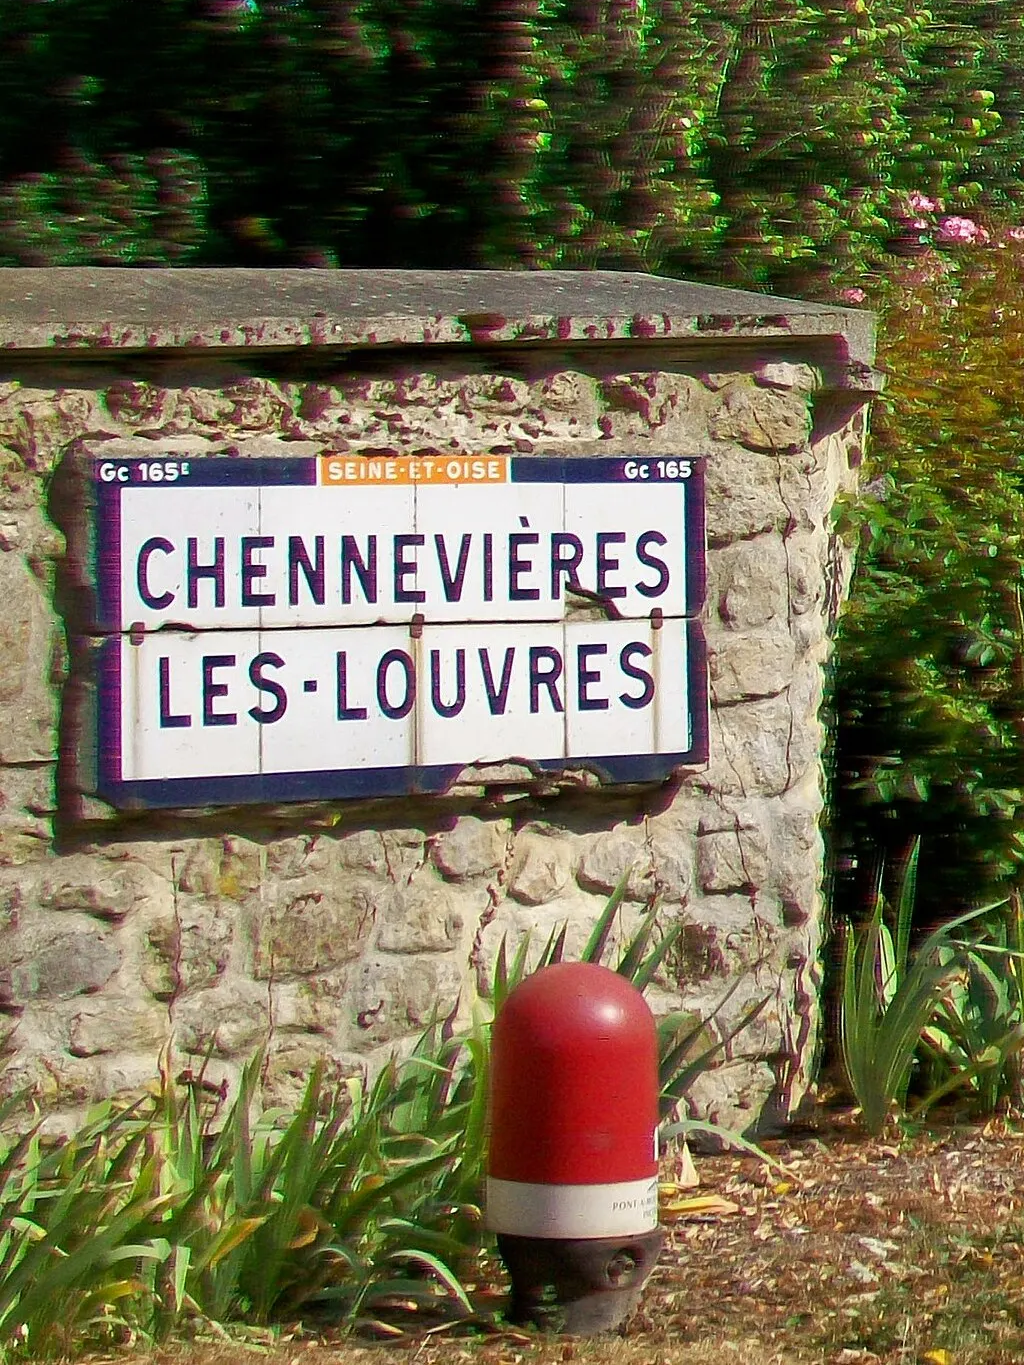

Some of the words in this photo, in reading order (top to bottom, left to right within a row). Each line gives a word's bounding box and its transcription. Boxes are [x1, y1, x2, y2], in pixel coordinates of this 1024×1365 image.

[99, 462, 129, 482] Gc
[624, 461, 650, 479] Gc
[136, 515, 670, 611] CHENNEVIÈRES
[158, 641, 656, 729] LES-LOUVRES
